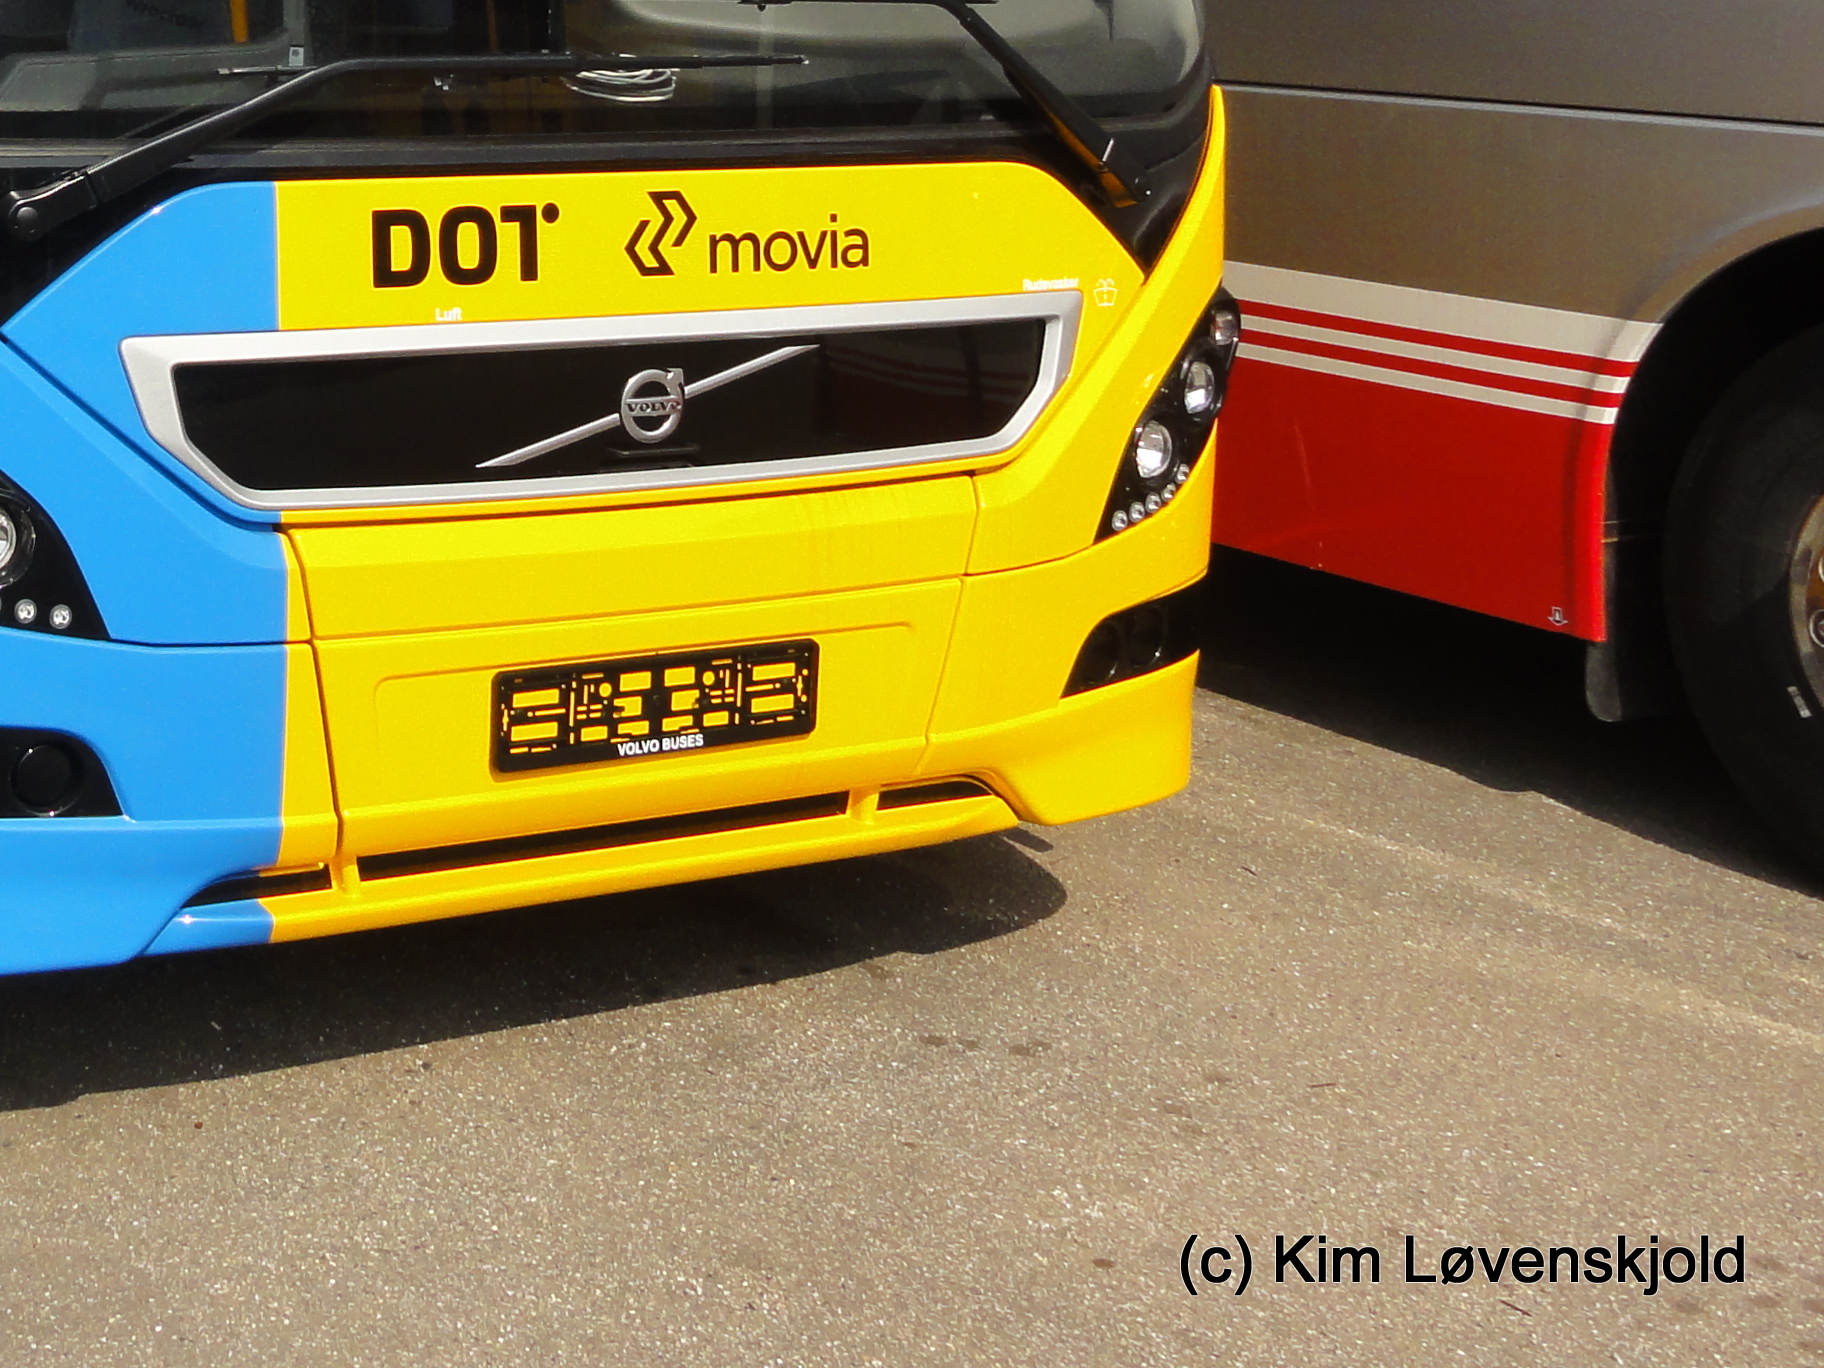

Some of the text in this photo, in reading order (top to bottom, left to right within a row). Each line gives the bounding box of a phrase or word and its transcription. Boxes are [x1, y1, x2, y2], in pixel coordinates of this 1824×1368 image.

[372, 205, 540, 288] DOT
[709, 213, 869, 273] movia
[435, 307, 463, 322] Luft
[625, 401, 682, 413] VOLVO
[617, 733, 704, 757] VOLVO BUSES
